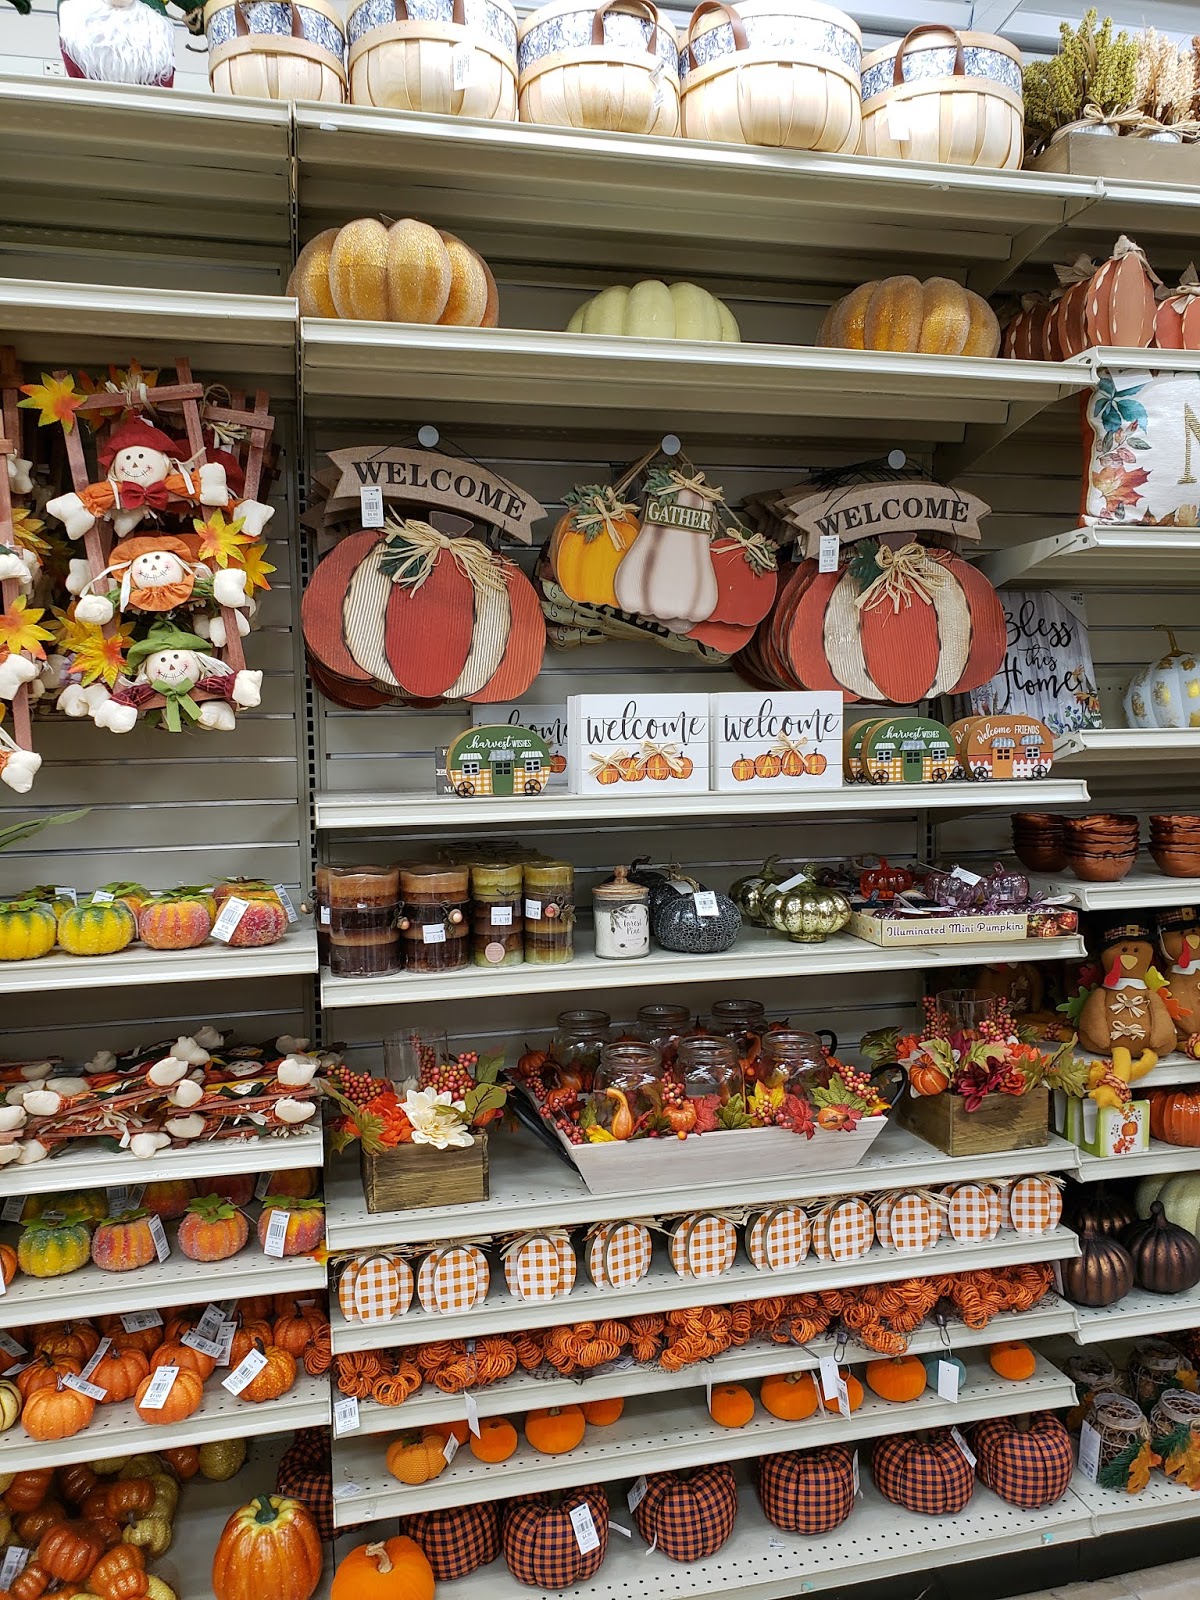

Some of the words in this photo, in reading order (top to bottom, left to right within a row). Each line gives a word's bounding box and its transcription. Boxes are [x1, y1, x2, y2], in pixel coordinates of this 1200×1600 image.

[352, 461, 527, 522] WELCOME
[648, 502, 711, 531] GATHER
[814, 497, 969, 536] WELCOME
[1003, 600, 1074, 648] Bless
[1018, 644, 1058, 671] this
[996, 652, 1083, 714] Home
[586, 700, 705, 746] welcome
[724, 698, 840, 742] welcome
[881, 726, 924, 740] harvest
[921, 730, 940, 739] WISHES
[976, 723, 1012, 745] Welcome
[1014, 724, 1040, 735] FRIENDS
[466, 735, 514, 749] harvest
[512, 740, 532, 748] WISHES
[602, 758, 685, 783] FAL
[886, 925, 945, 937] Illuminated
[948, 923, 974, 934] Mini
[976, 921, 1024, 934] Pumpkins
